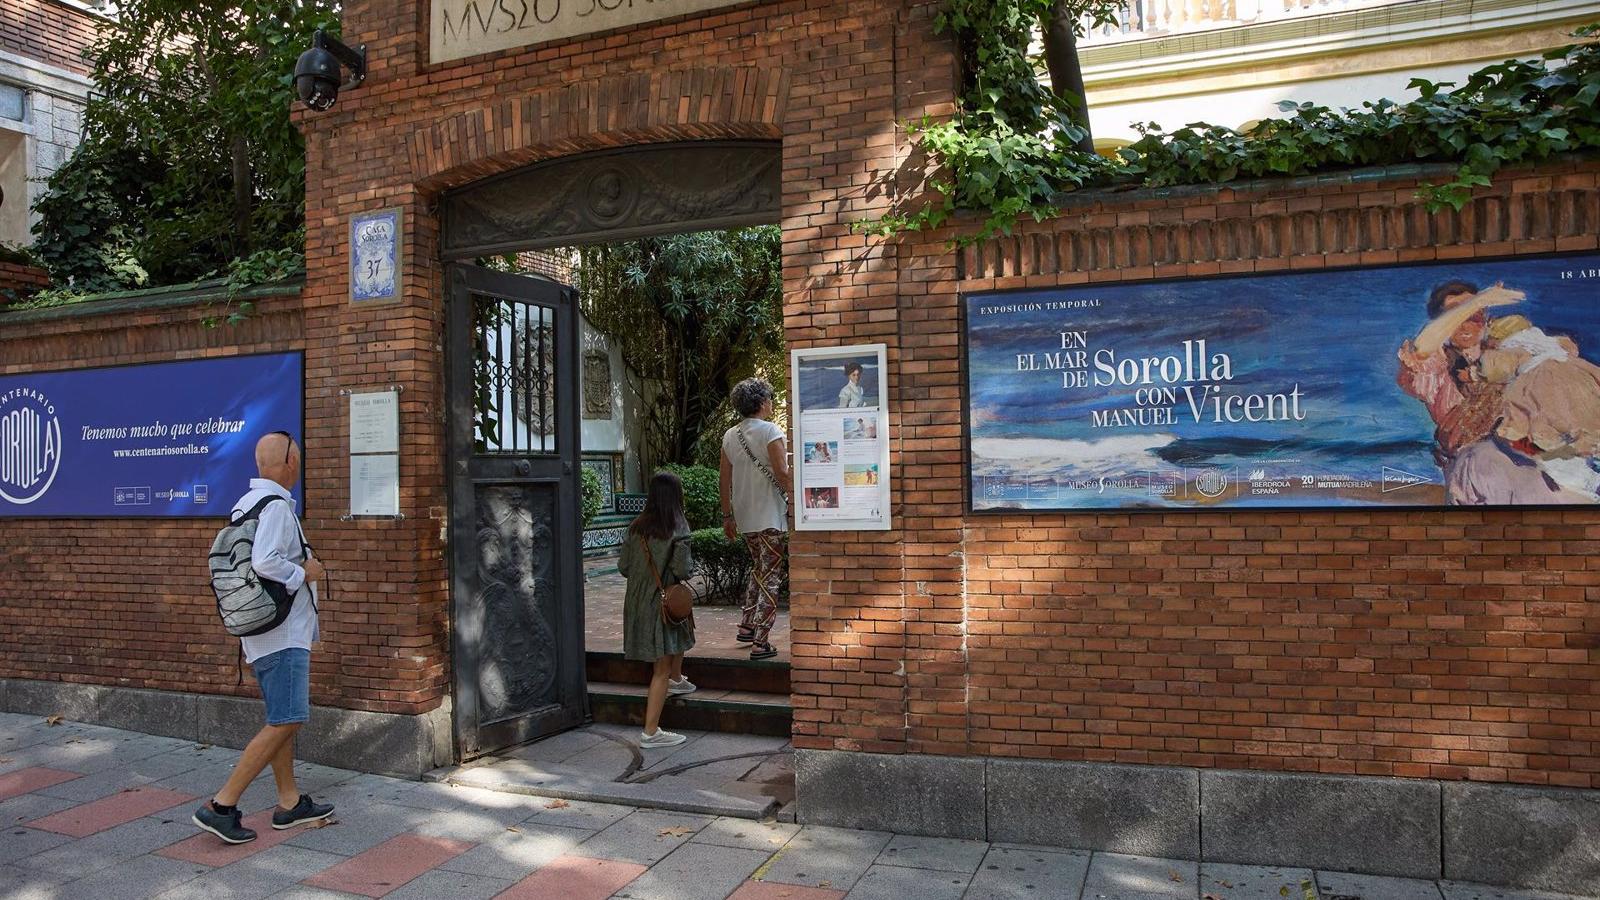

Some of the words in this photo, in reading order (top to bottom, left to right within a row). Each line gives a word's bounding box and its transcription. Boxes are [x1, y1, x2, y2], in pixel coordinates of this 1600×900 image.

[366, 258, 382, 279] 37
[1561, 271, 1573, 279] 18
[980, 302, 1042, 315] EXPOSICIÓN
[1046, 298, 1101, 310] TEMPORAL
[1060, 331, 1088, 349] EN
[1016, 354, 1040, 372] EL
[1044, 351, 1089, 370] MAR
[1062, 371, 1088, 389] DE
[1093, 339, 1234, 388] Sorolla
[0, 388, 54, 414] NTENARIO
[1091, 407, 1178, 428] MANUEL
[1182, 382, 1307, 424] Vicent
[1135, 387, 1177, 406] CON
[82, 425, 127, 441] Tenemos
[130, 421, 168, 438] mucho
[171, 423, 193, 440] que
[196, 417, 246, 435] celebrar
[0, 407, 55, 489] OROLLA
[113, 444, 209, 458] www.centenariosorolla.es
[1068, 480, 1098, 490] MUSEO
[1098, 477, 1139, 494] SOROLLA
[1301, 475, 1314, 484] 20
